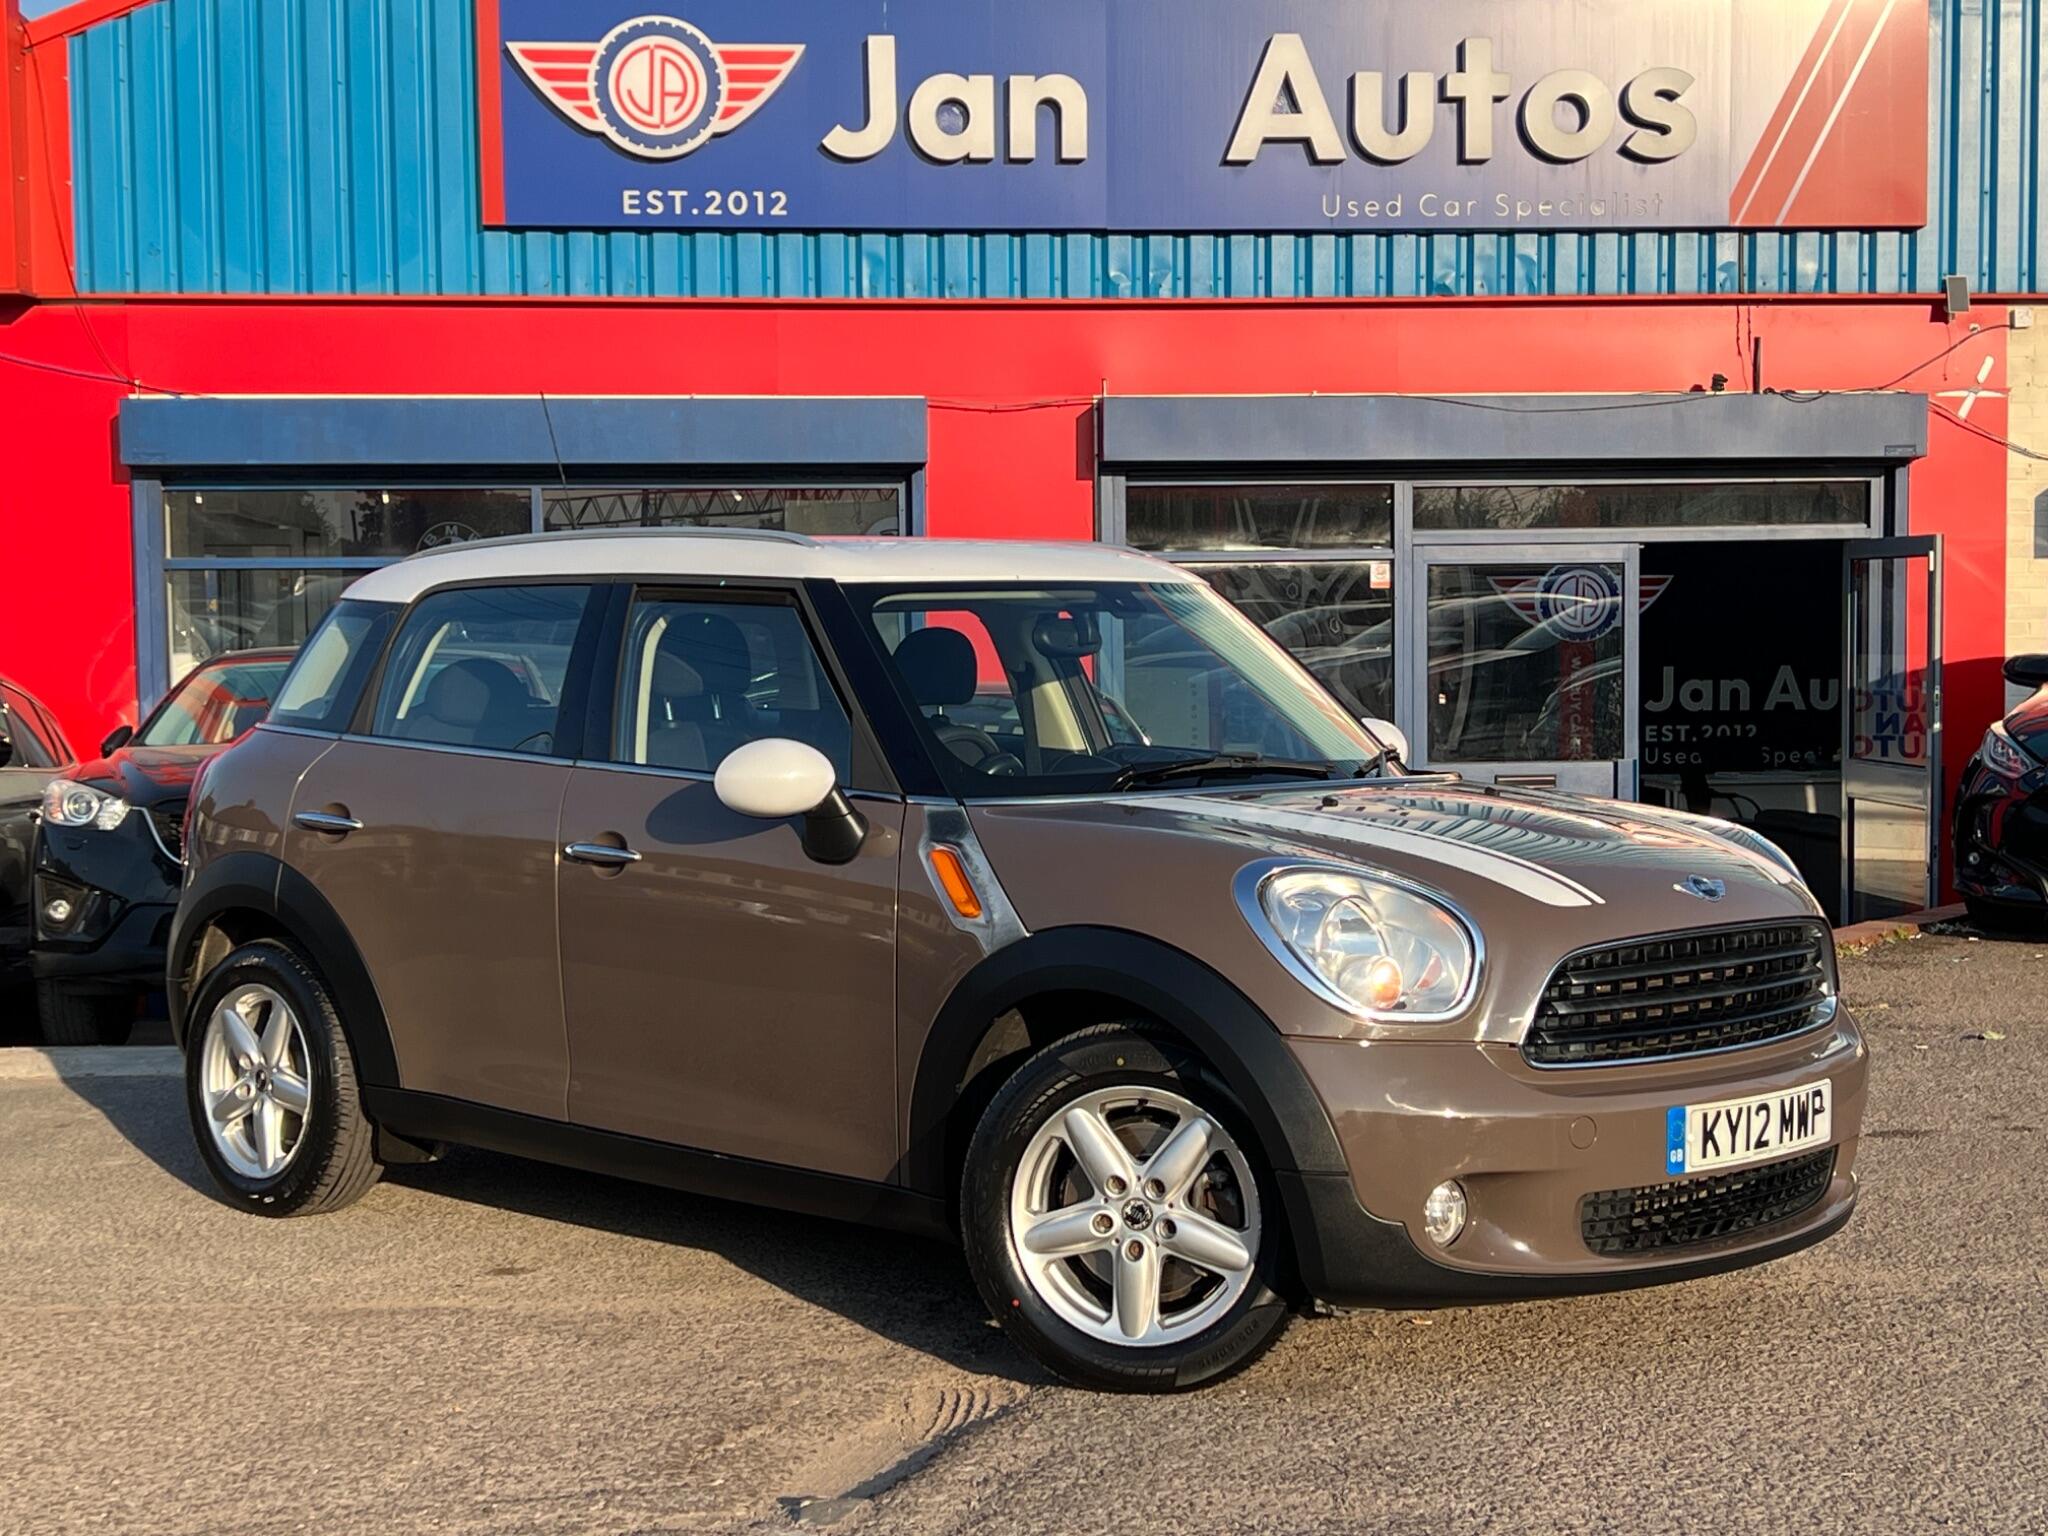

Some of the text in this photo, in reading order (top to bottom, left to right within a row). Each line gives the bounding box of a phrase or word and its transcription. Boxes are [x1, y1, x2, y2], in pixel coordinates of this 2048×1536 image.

[821, 34, 1698, 162] Jan Autos
[622, 190, 788, 215] EST.2012
[1322, 192, 1664, 221] Used Car Specialist
[1645, 665, 1840, 712] Jan Au
[1701, 1088, 1825, 1160] KY12 MWP
